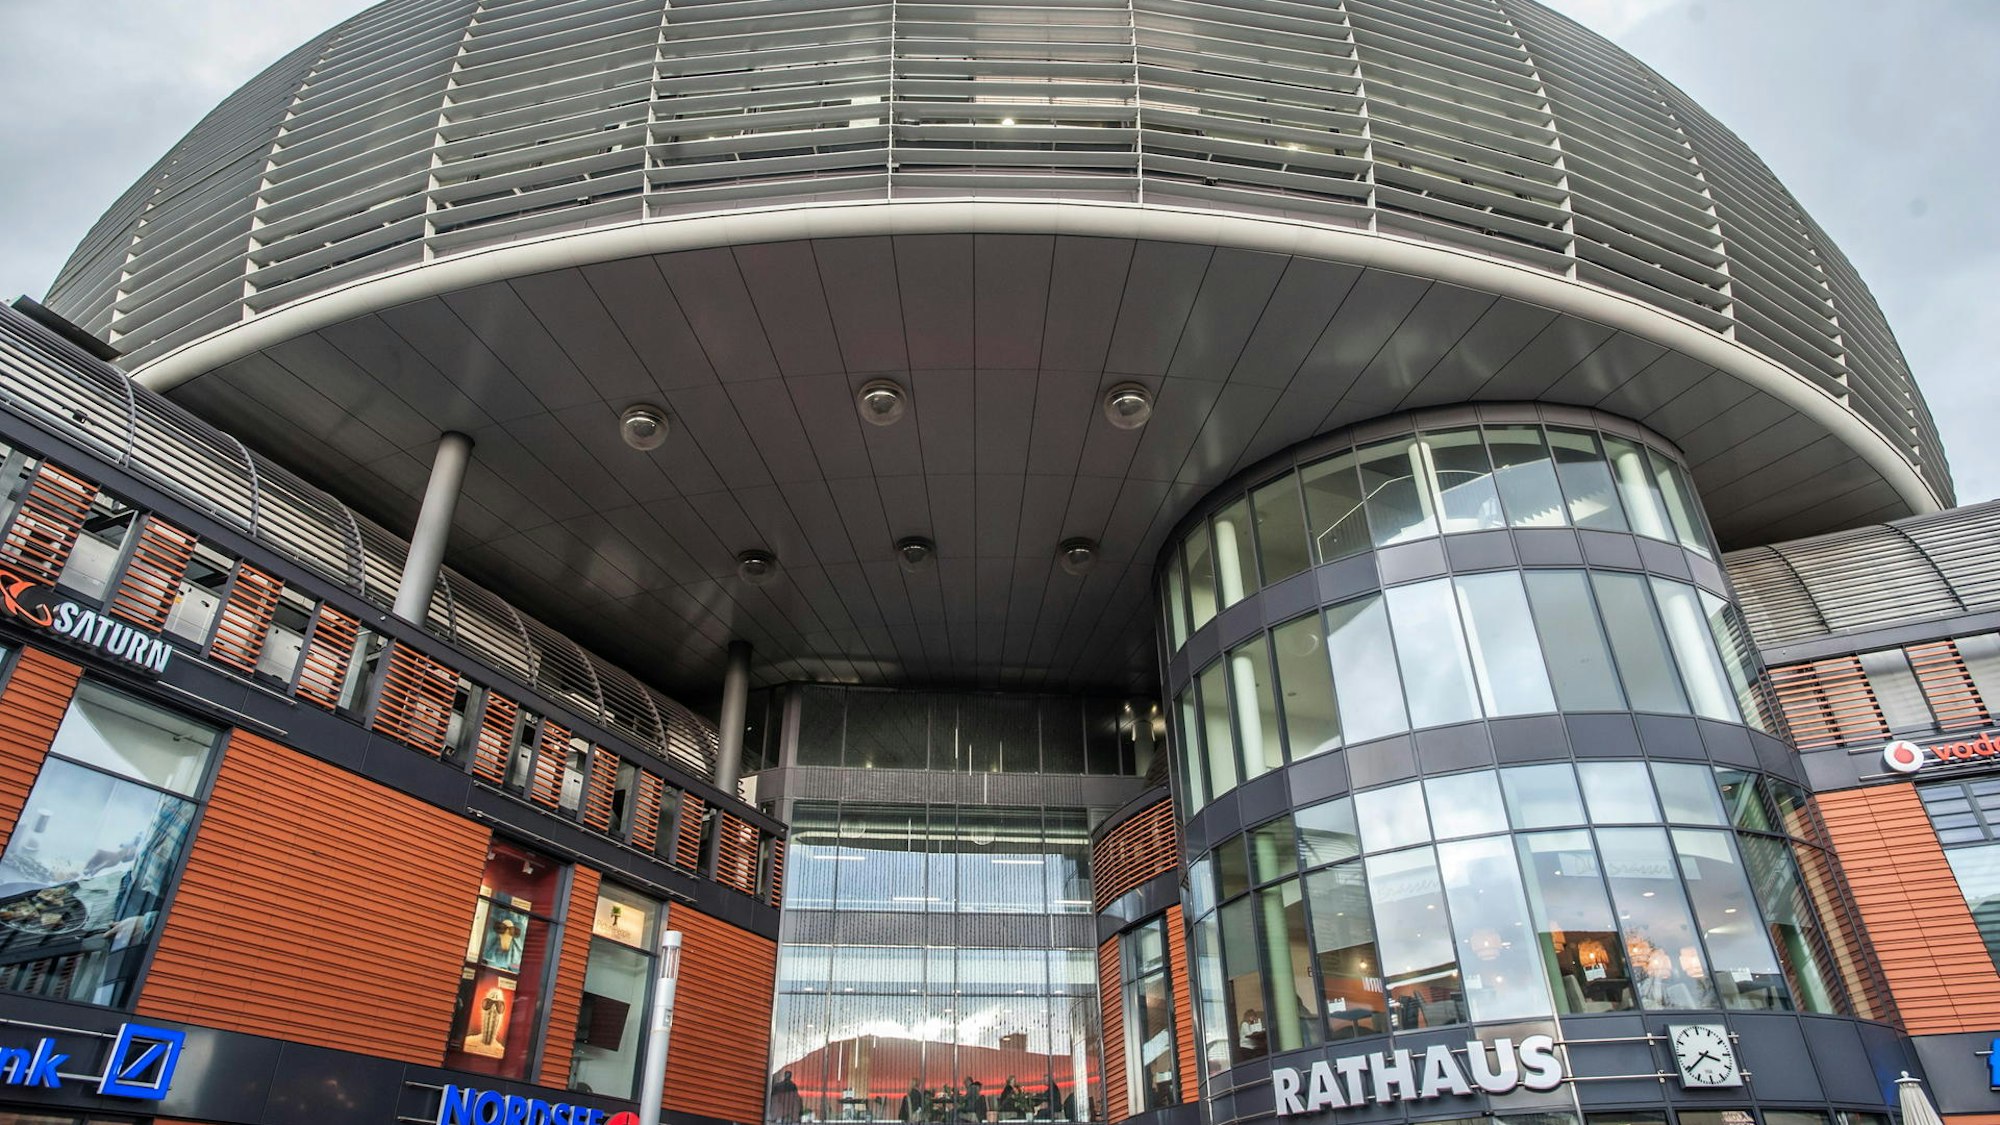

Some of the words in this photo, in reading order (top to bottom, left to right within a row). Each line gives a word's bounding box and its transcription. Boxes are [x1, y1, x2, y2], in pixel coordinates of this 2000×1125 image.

[53, 602, 173, 673] SATURN
[0, 1037, 71, 1088] nk
[1272, 1034, 1562, 1116] RATHAUS
